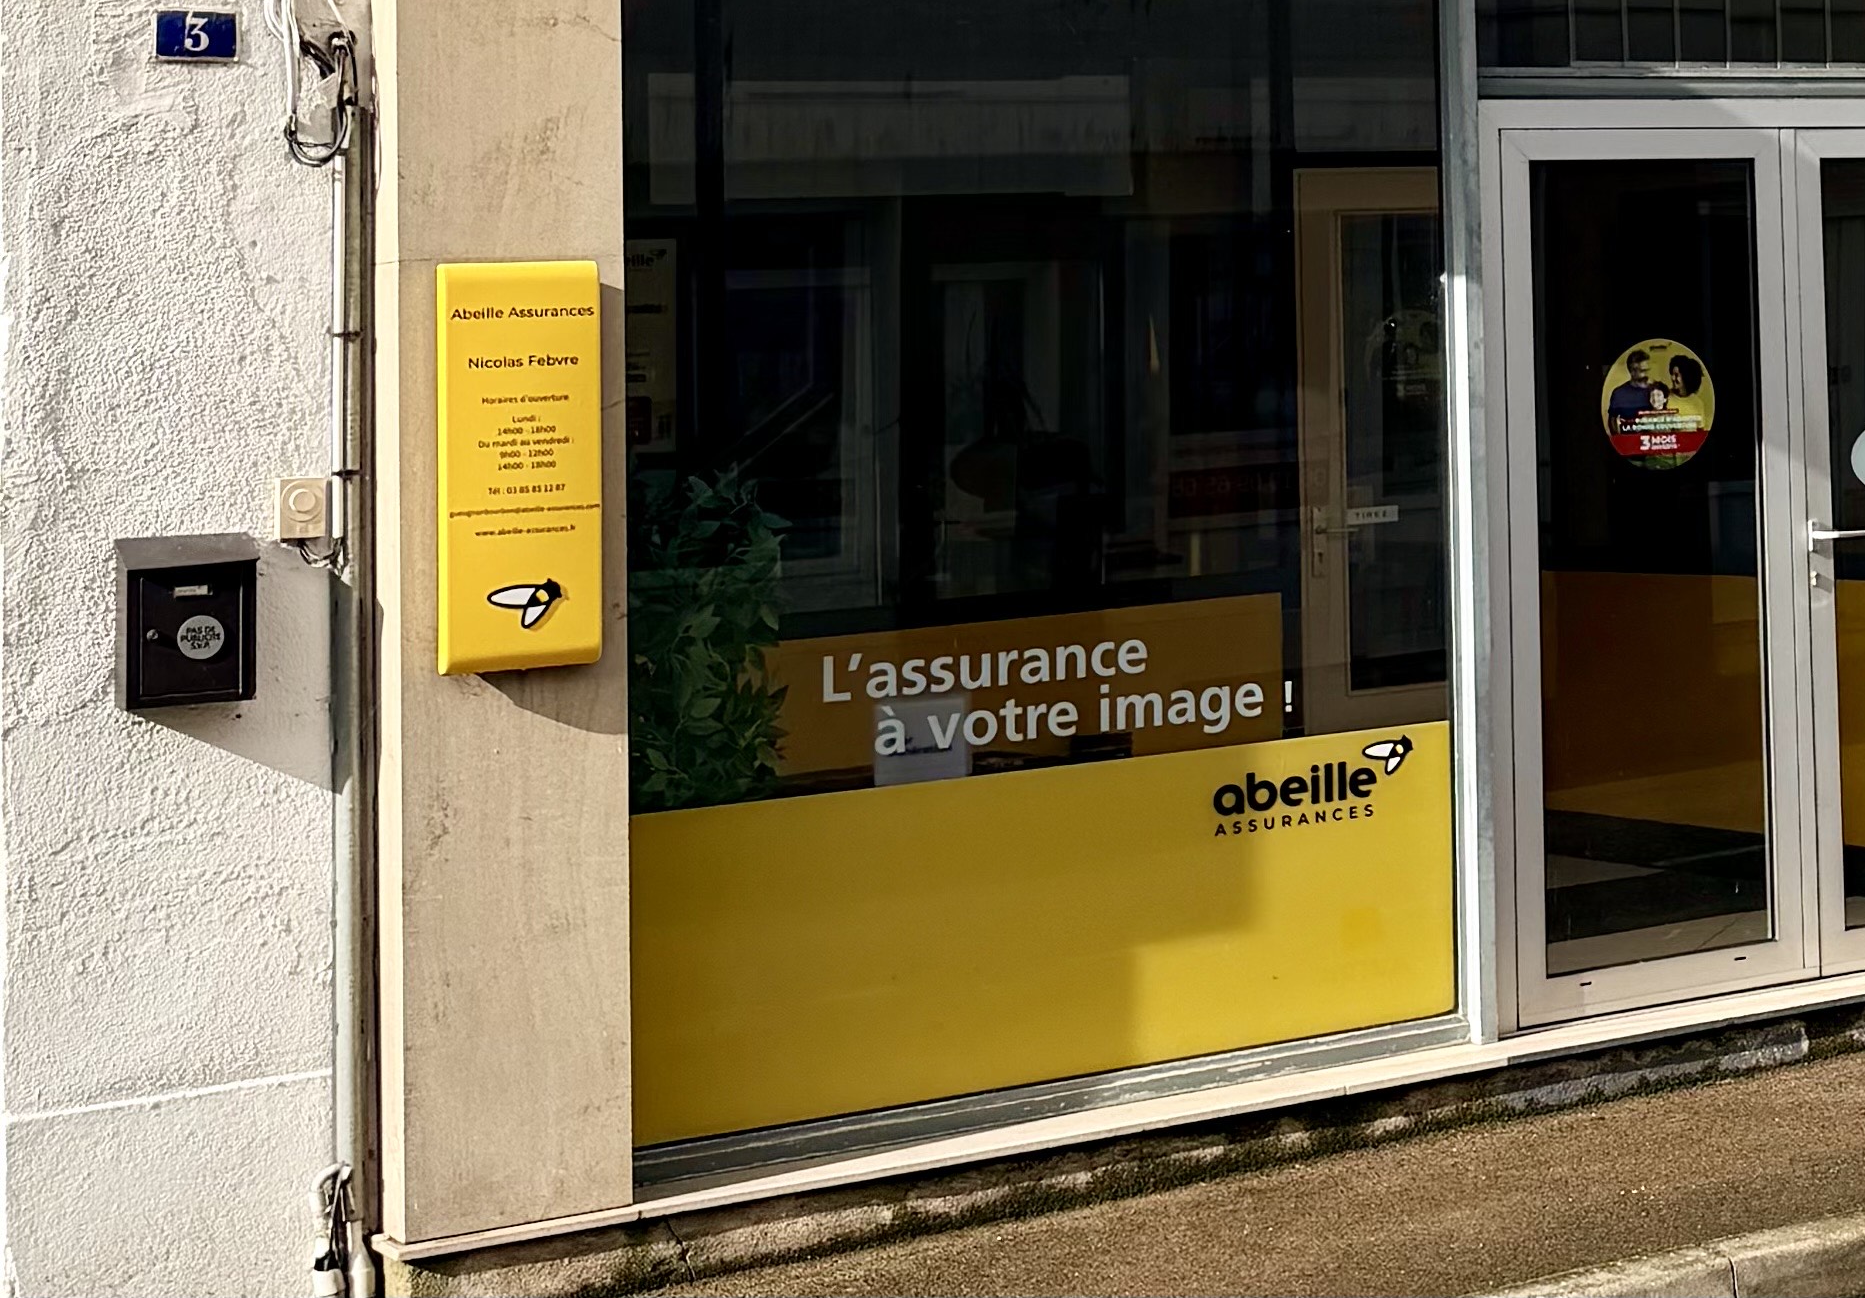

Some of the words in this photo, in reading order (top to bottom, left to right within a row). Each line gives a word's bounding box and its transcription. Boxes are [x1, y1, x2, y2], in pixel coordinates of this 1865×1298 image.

[185, 17, 209, 51] 3
[450, 307, 504, 320] Abeille
[508, 306, 594, 318] Assurances
[468, 356, 523, 369] Nicolas
[528, 354, 579, 367] Febvre
[482, 396, 517, 404] Horaires
[512, 415, 536, 423] Lundi
[498, 427, 523, 435] 14h00
[478, 440, 490, 448] Du
[492, 438, 517, 447] mardi
[533, 436, 570, 445] vendredi
[1640, 435, 1651, 450] 3
[1651, 435, 1677, 444] MOIS
[822, 637, 1148, 703] L'assurance
[874, 706, 906, 755] à
[927, 698, 1079, 750] votre
[1099, 682, 1264, 734] image
[1282, 680, 1294, 714] !
[1213, 761, 1377, 817] abeille
[1215, 805, 1374, 837] ASSURANCES
